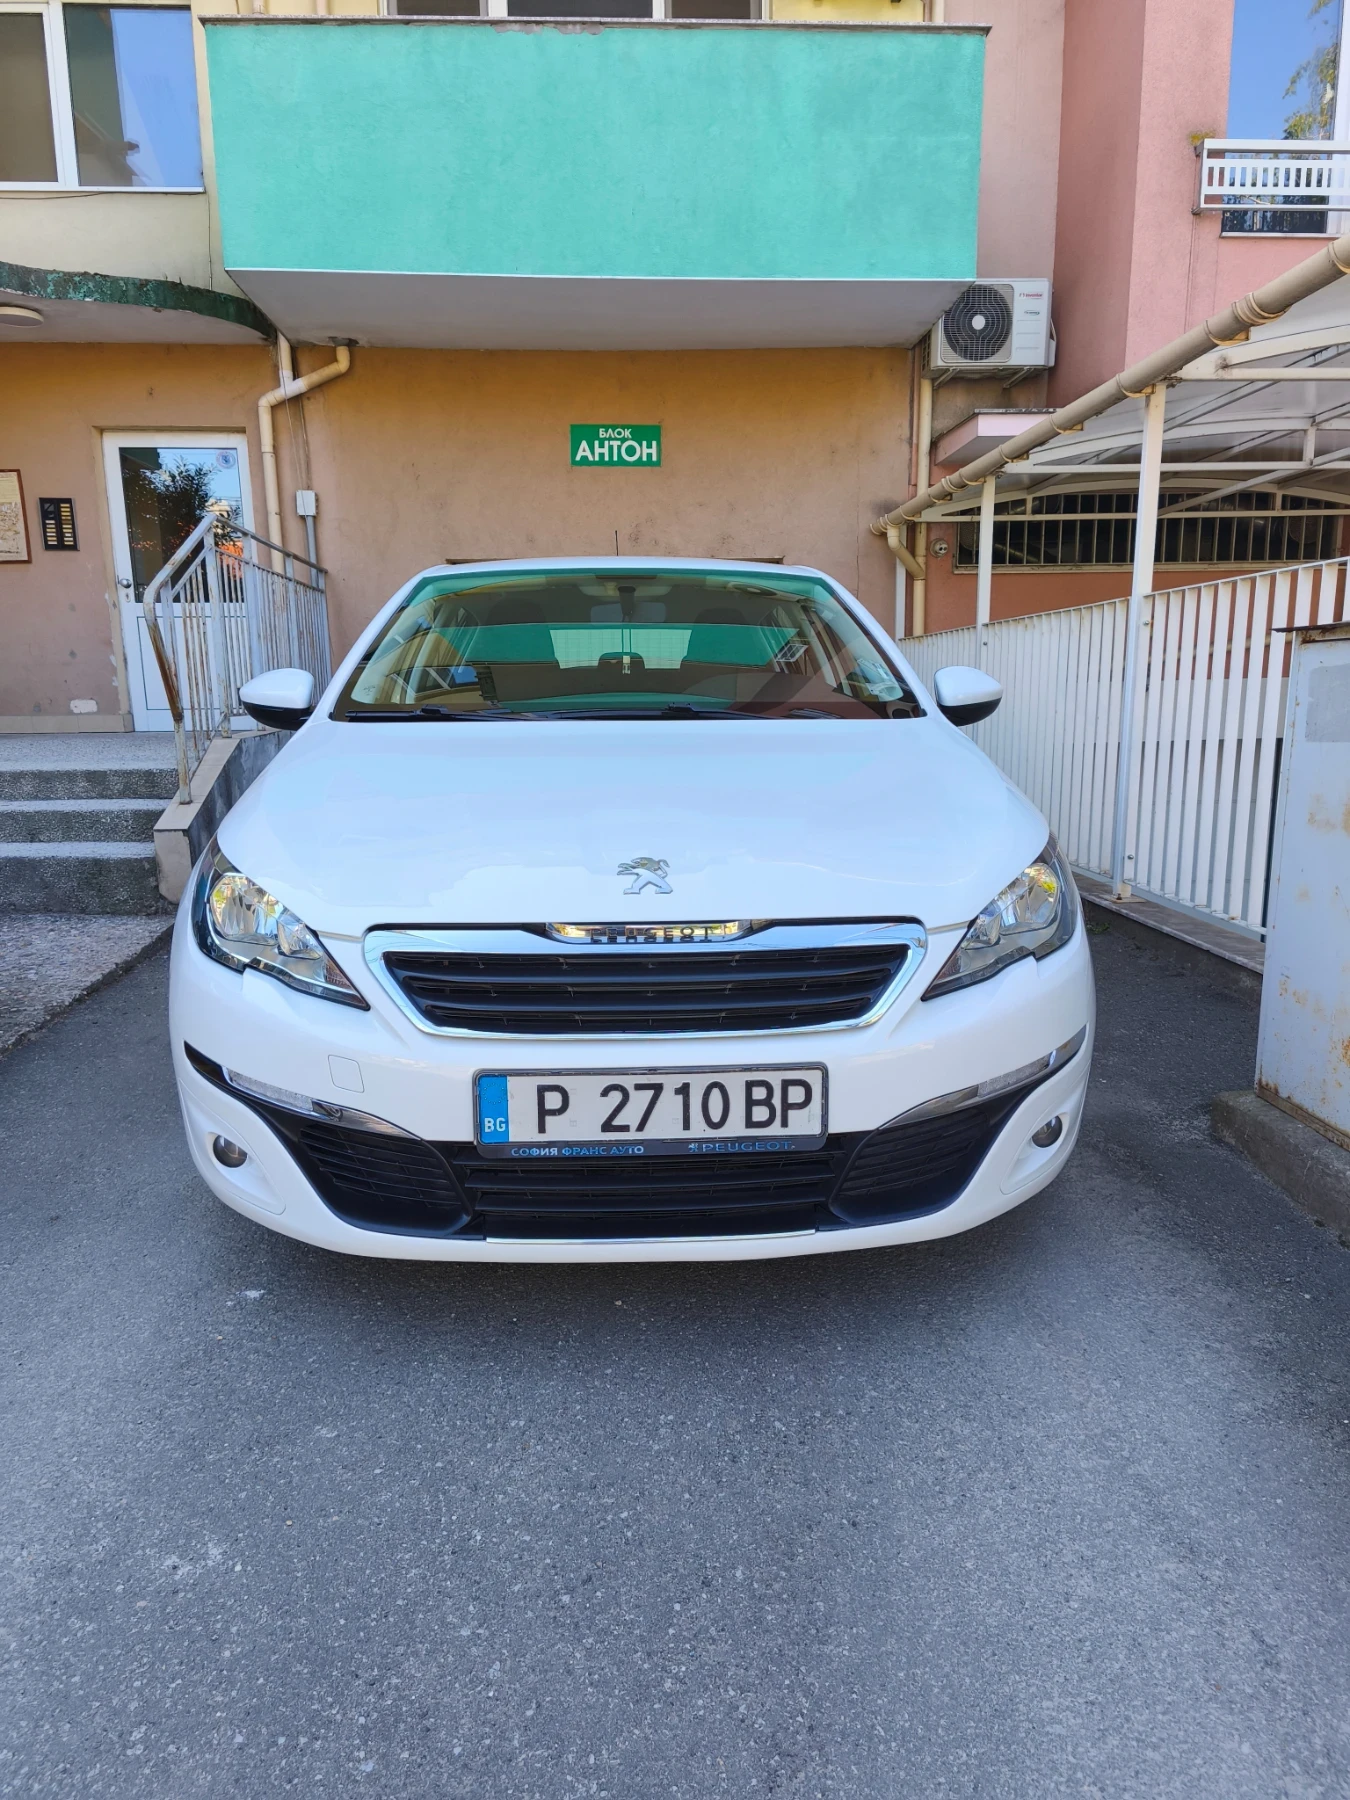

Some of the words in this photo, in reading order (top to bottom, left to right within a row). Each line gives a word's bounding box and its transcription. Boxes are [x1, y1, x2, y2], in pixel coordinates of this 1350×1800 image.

[599, 428, 632, 438] БЛОК
[575, 440, 657, 461] АНТОН
[536, 1084, 570, 1134] P
[600, 1080, 731, 1133] 2710
[744, 1078, 813, 1129] BP
[484, 1117, 506, 1133] BG
[511, 1147, 558, 1157] СОФИЯ
[562, 1146, 607, 1156] ФРАНС
[610, 1145, 644, 1155] АУТО
[702, 1141, 792, 1152] PEUGEOT
